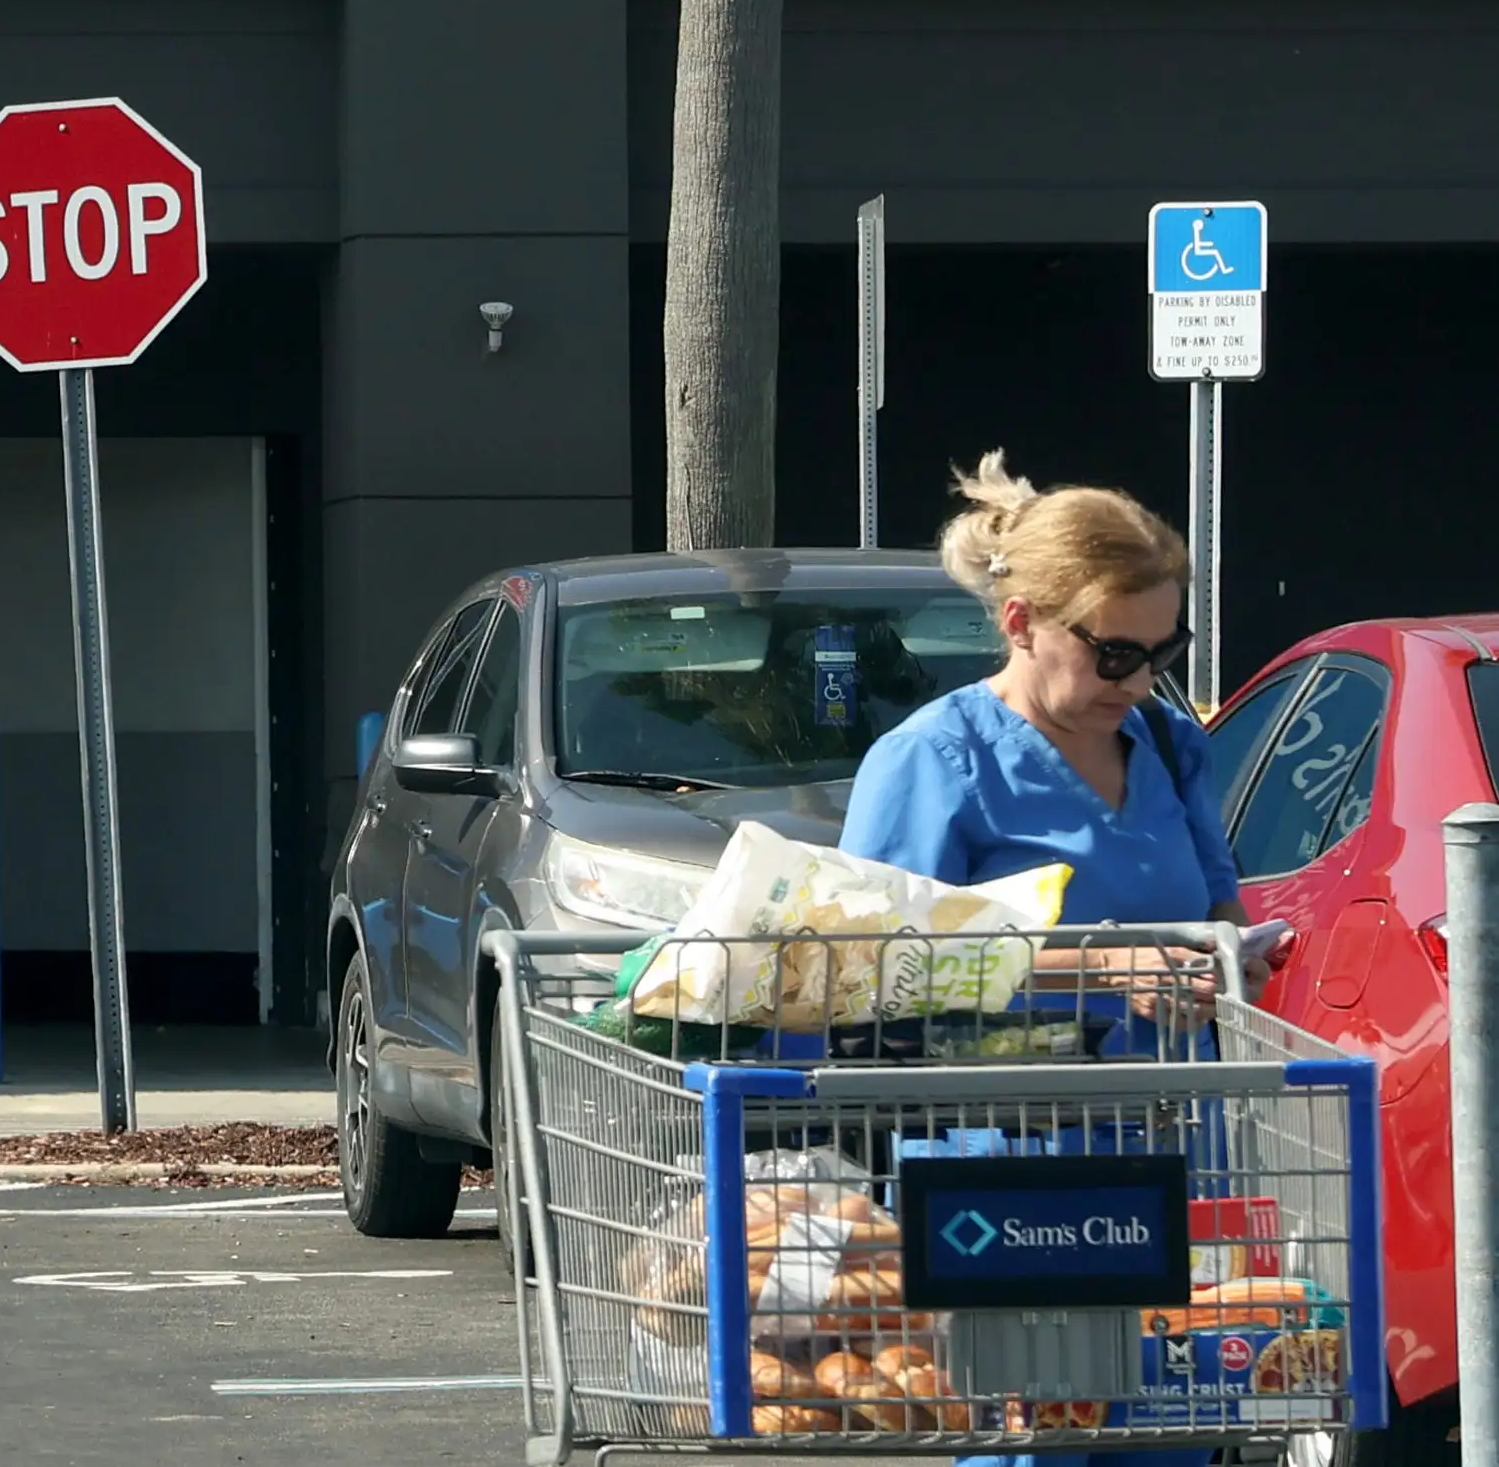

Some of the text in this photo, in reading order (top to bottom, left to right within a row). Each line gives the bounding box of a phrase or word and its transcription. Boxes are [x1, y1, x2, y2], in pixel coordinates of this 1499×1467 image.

[1157, 295, 1257, 309] PARKING BY DISABLED
[1177, 315, 1236, 327] PERMIT ONLY
[1170, 335, 1245, 348] TOW-AWAY ZONE
[1167, 356, 1186, 368] FINE
[1191, 356, 1203, 368] UP
[1208, 356, 1219, 367] TO
[1003, 1216, 1150, 1246] Sam's Club
